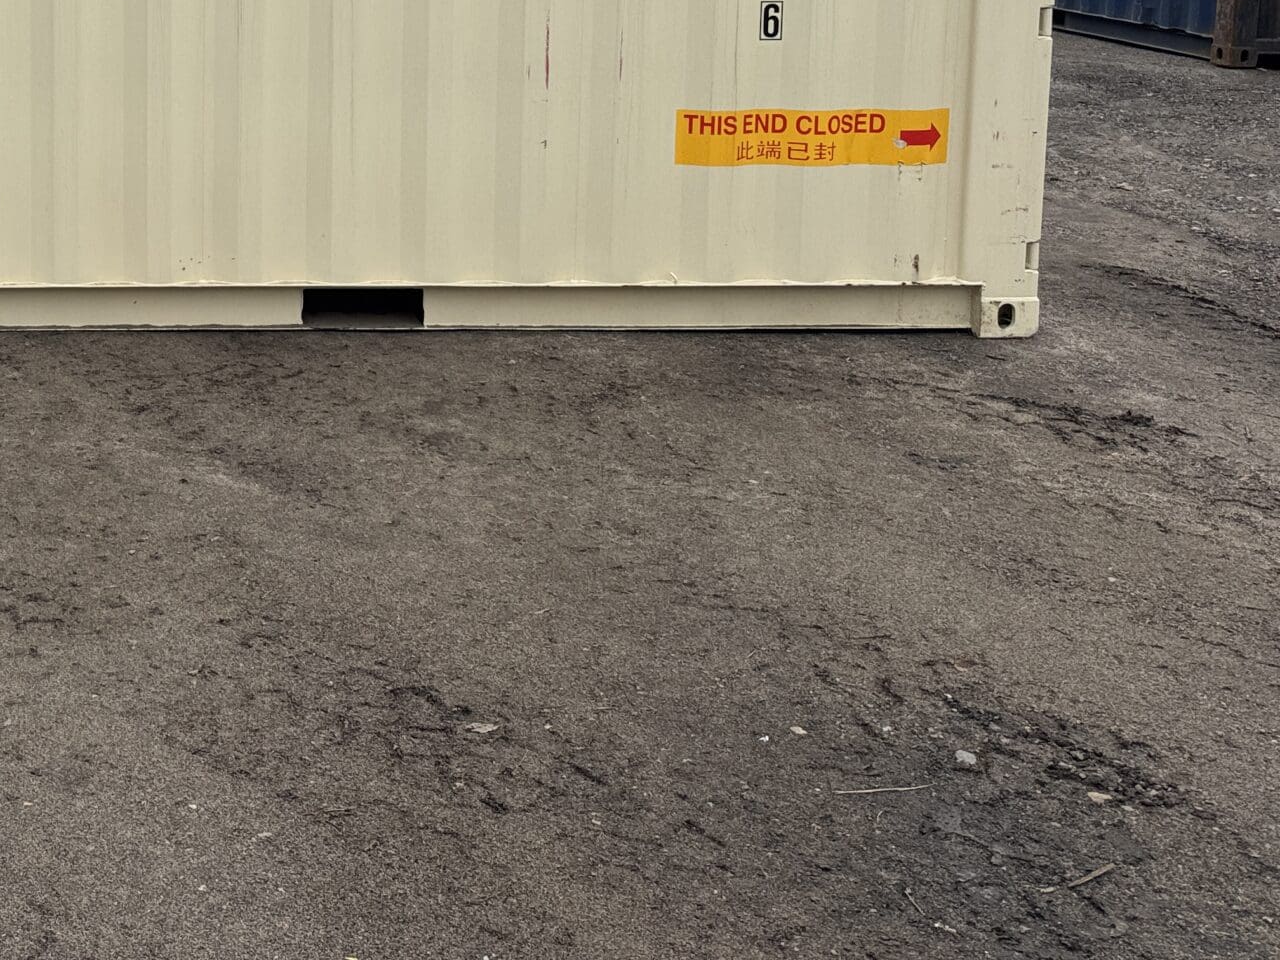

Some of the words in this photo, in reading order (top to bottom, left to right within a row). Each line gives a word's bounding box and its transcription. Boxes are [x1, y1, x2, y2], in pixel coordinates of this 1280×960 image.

[762, 3, 780, 38] 6
[683, 113, 738, 136] THIS
[742, 113, 788, 134] END
[795, 113, 886, 135] CLOSED
[736, 140, 837, 161] 此端已封
